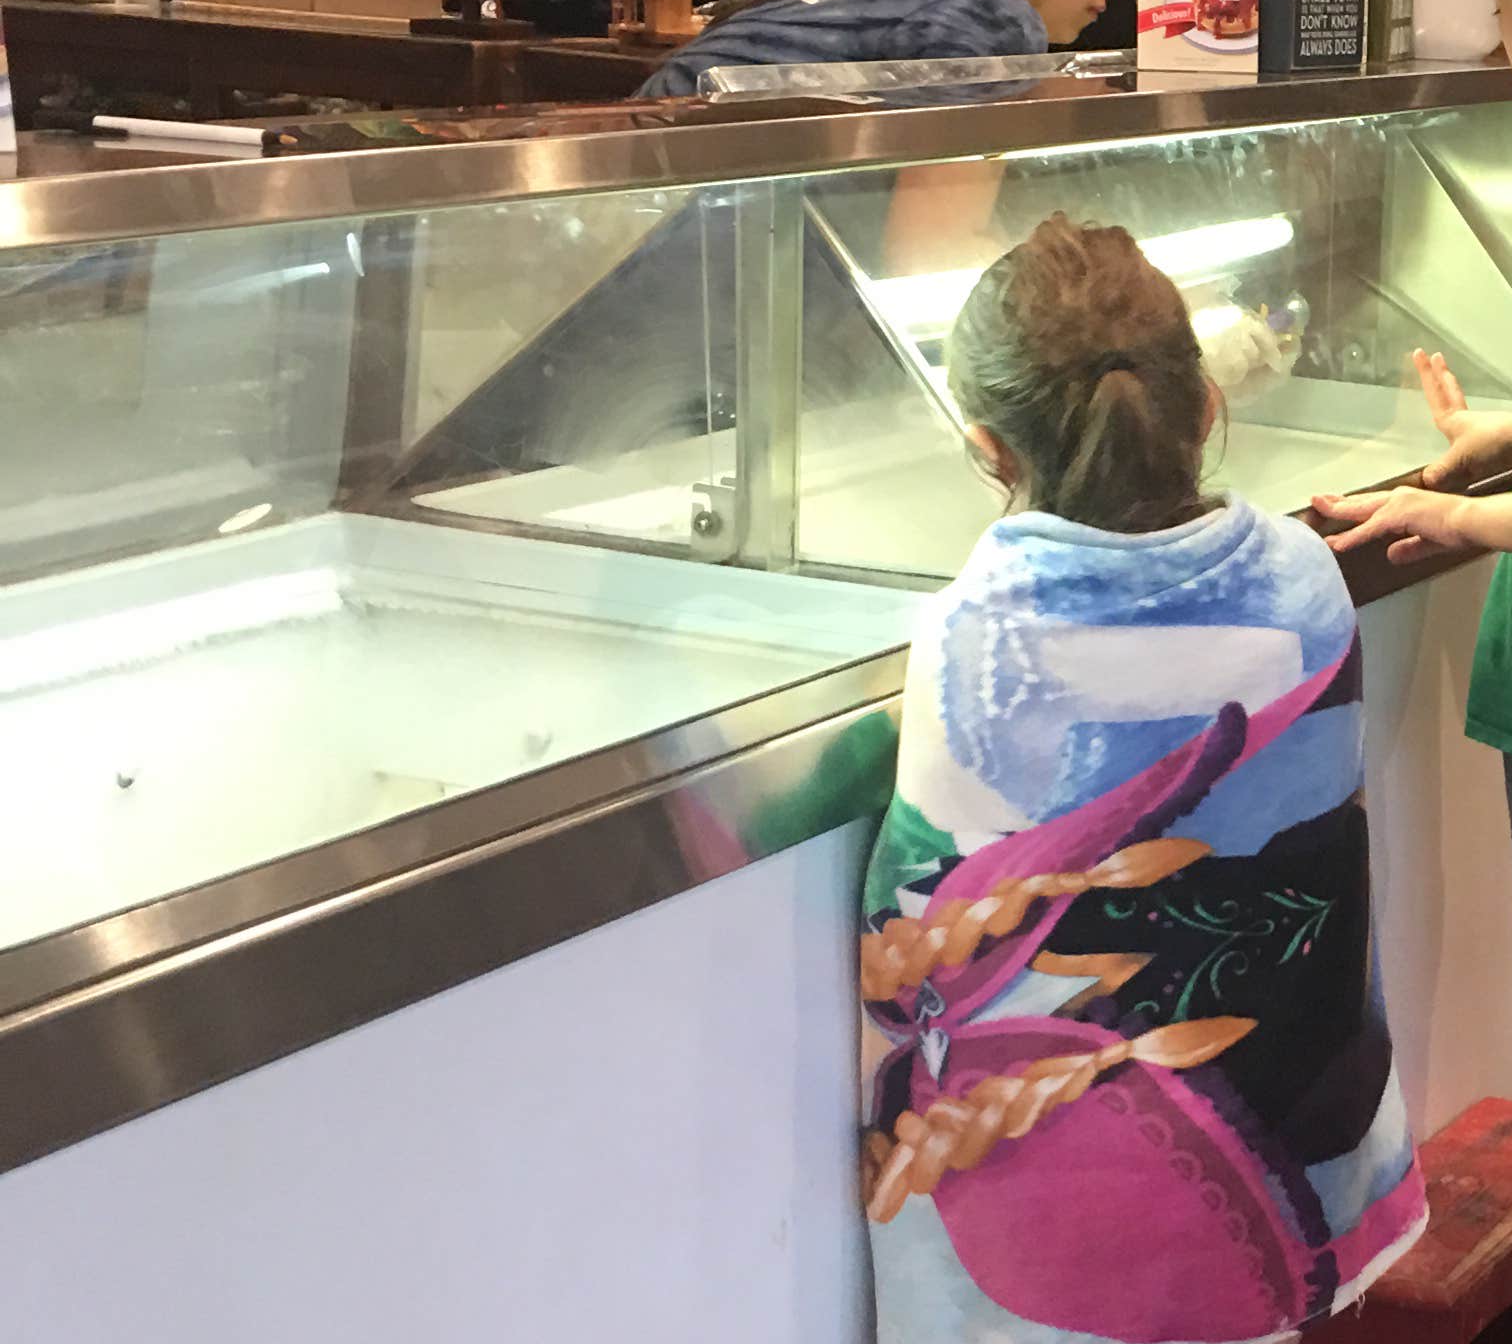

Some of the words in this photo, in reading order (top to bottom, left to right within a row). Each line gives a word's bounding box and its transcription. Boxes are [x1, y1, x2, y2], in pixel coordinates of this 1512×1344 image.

[1300, 15, 1328, 30] DON'T
[1330, 15, 1358, 29] KNOW
[1300, 39, 1333, 57] ALWAYS
[1334, 38, 1358, 56] DOES
